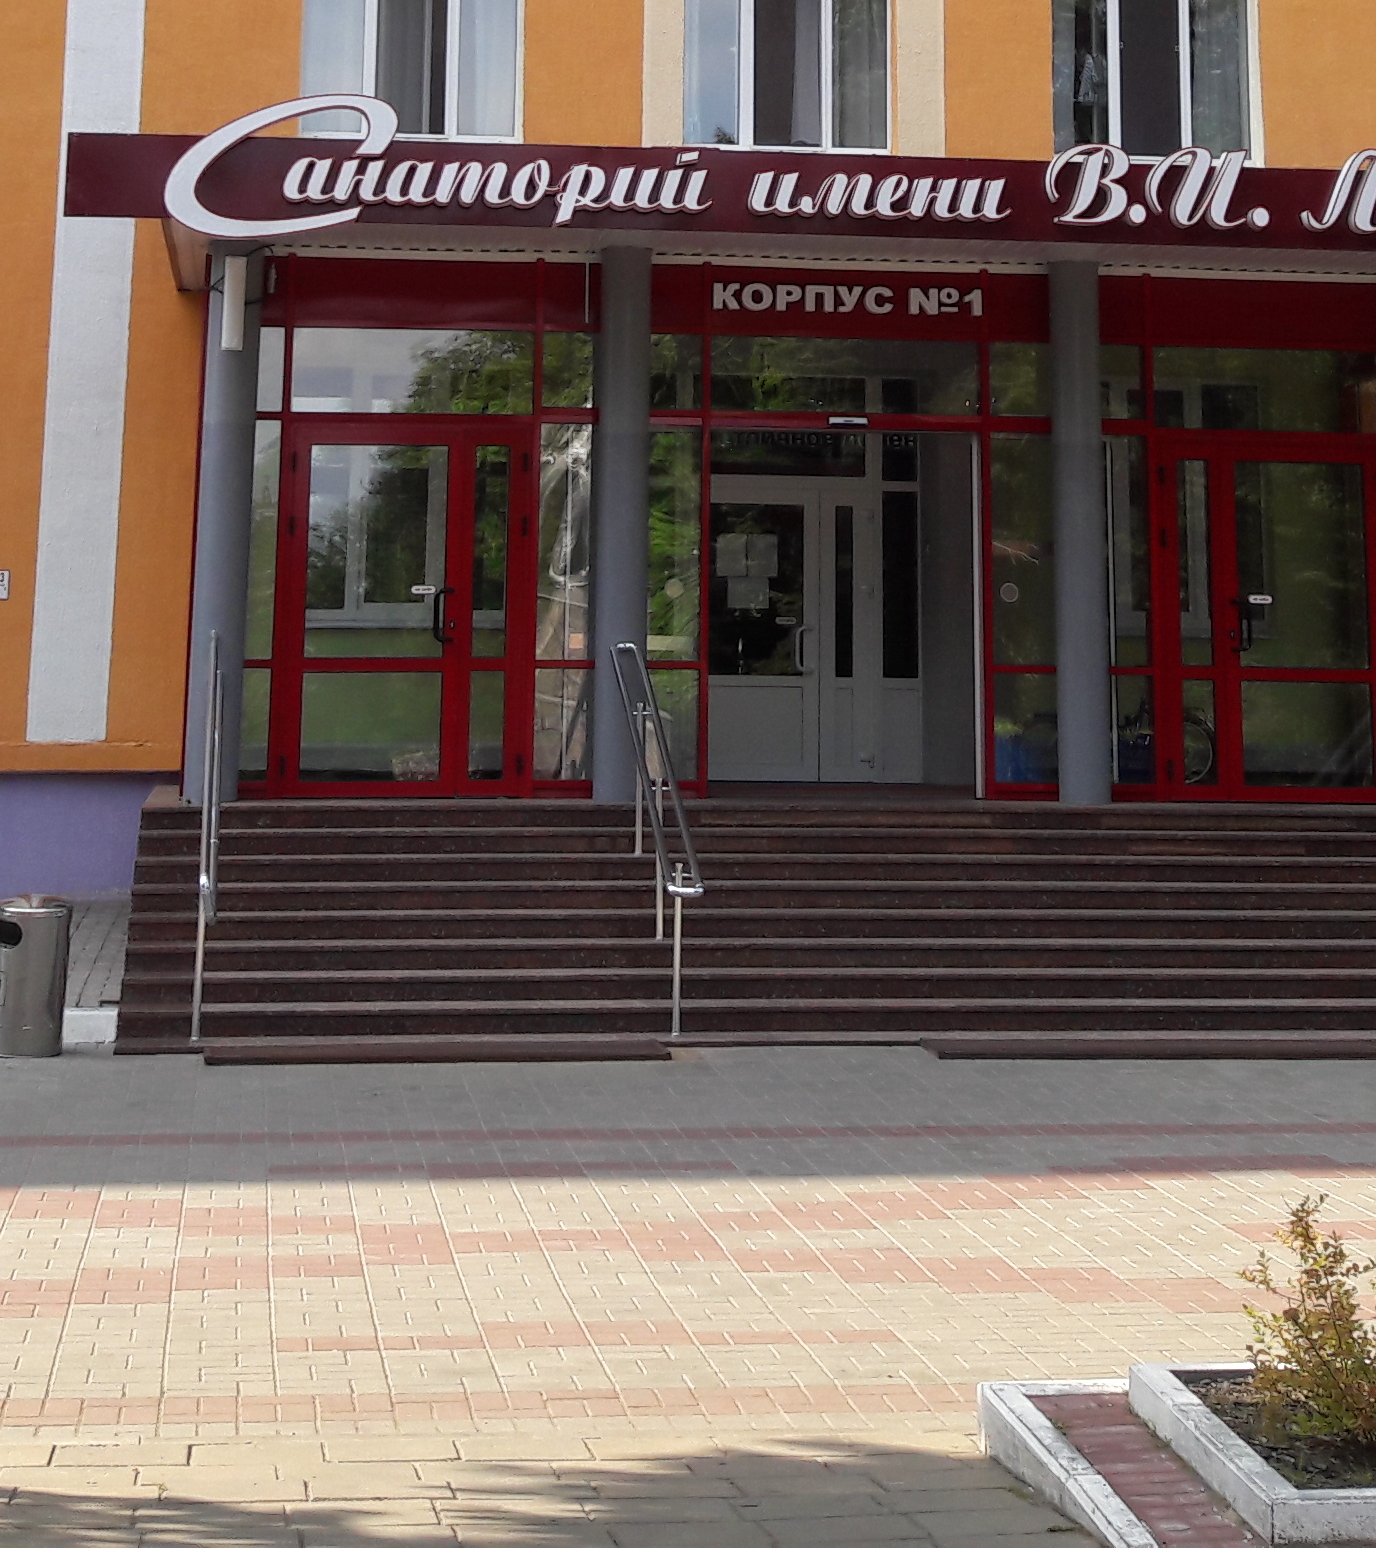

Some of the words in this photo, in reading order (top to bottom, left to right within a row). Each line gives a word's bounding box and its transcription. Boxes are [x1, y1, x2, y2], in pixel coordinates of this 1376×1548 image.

[163, 93, 713, 239] Санаторий
[747, 166, 1012, 224] имени
[1045, 143, 1270, 230] В.И.
[712, 282, 895, 314] КОРПУС
[908, 287, 983, 316] №1
